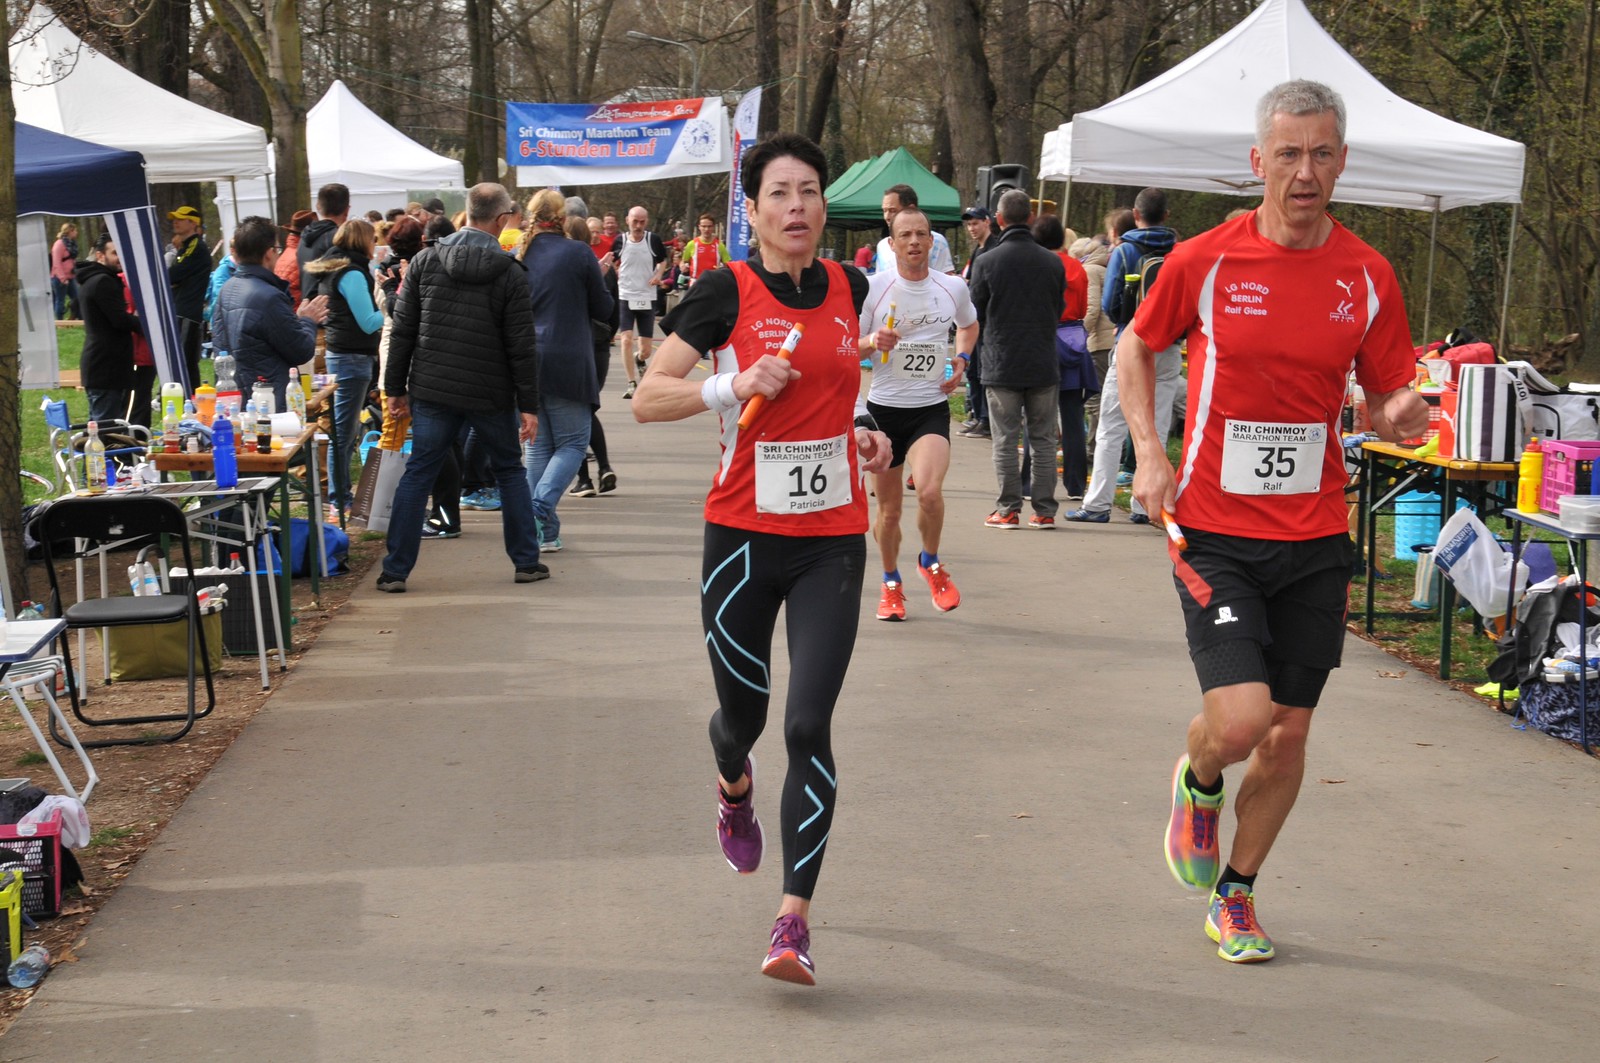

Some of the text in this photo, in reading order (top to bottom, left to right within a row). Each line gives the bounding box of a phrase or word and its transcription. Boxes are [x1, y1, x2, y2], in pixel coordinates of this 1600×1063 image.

[519, 126, 672, 142] Sri Chinmoy Marathon Team
[519, 137, 657, 158] 6-Stunden Lauf
[732, 206, 740, 224] Sri
[1224, 281, 1270, 296] LG NORD
[1231, 294, 1263, 304] BERLIN
[1224, 305, 1268, 316] Ralf Giese
[750, 317, 793, 332] LG NORD
[758, 330, 788, 339] BERLIN
[903, 354, 936, 372] 229
[1232, 424, 1252, 433] SRI
[1254, 425, 1307, 435] CHINMOY
[1232, 432, 1280, 442] MARATHON
[763, 445, 782, 453] SRI
[785, 441, 834, 453] CHINMOY
[763, 450, 834, 461] MARATHON TEAM
[1254, 446, 1297, 478] 35
[788, 464, 828, 497] 16
[1263, 482, 1283, 491] Ralf
[790, 499, 826, 510] Patricia
